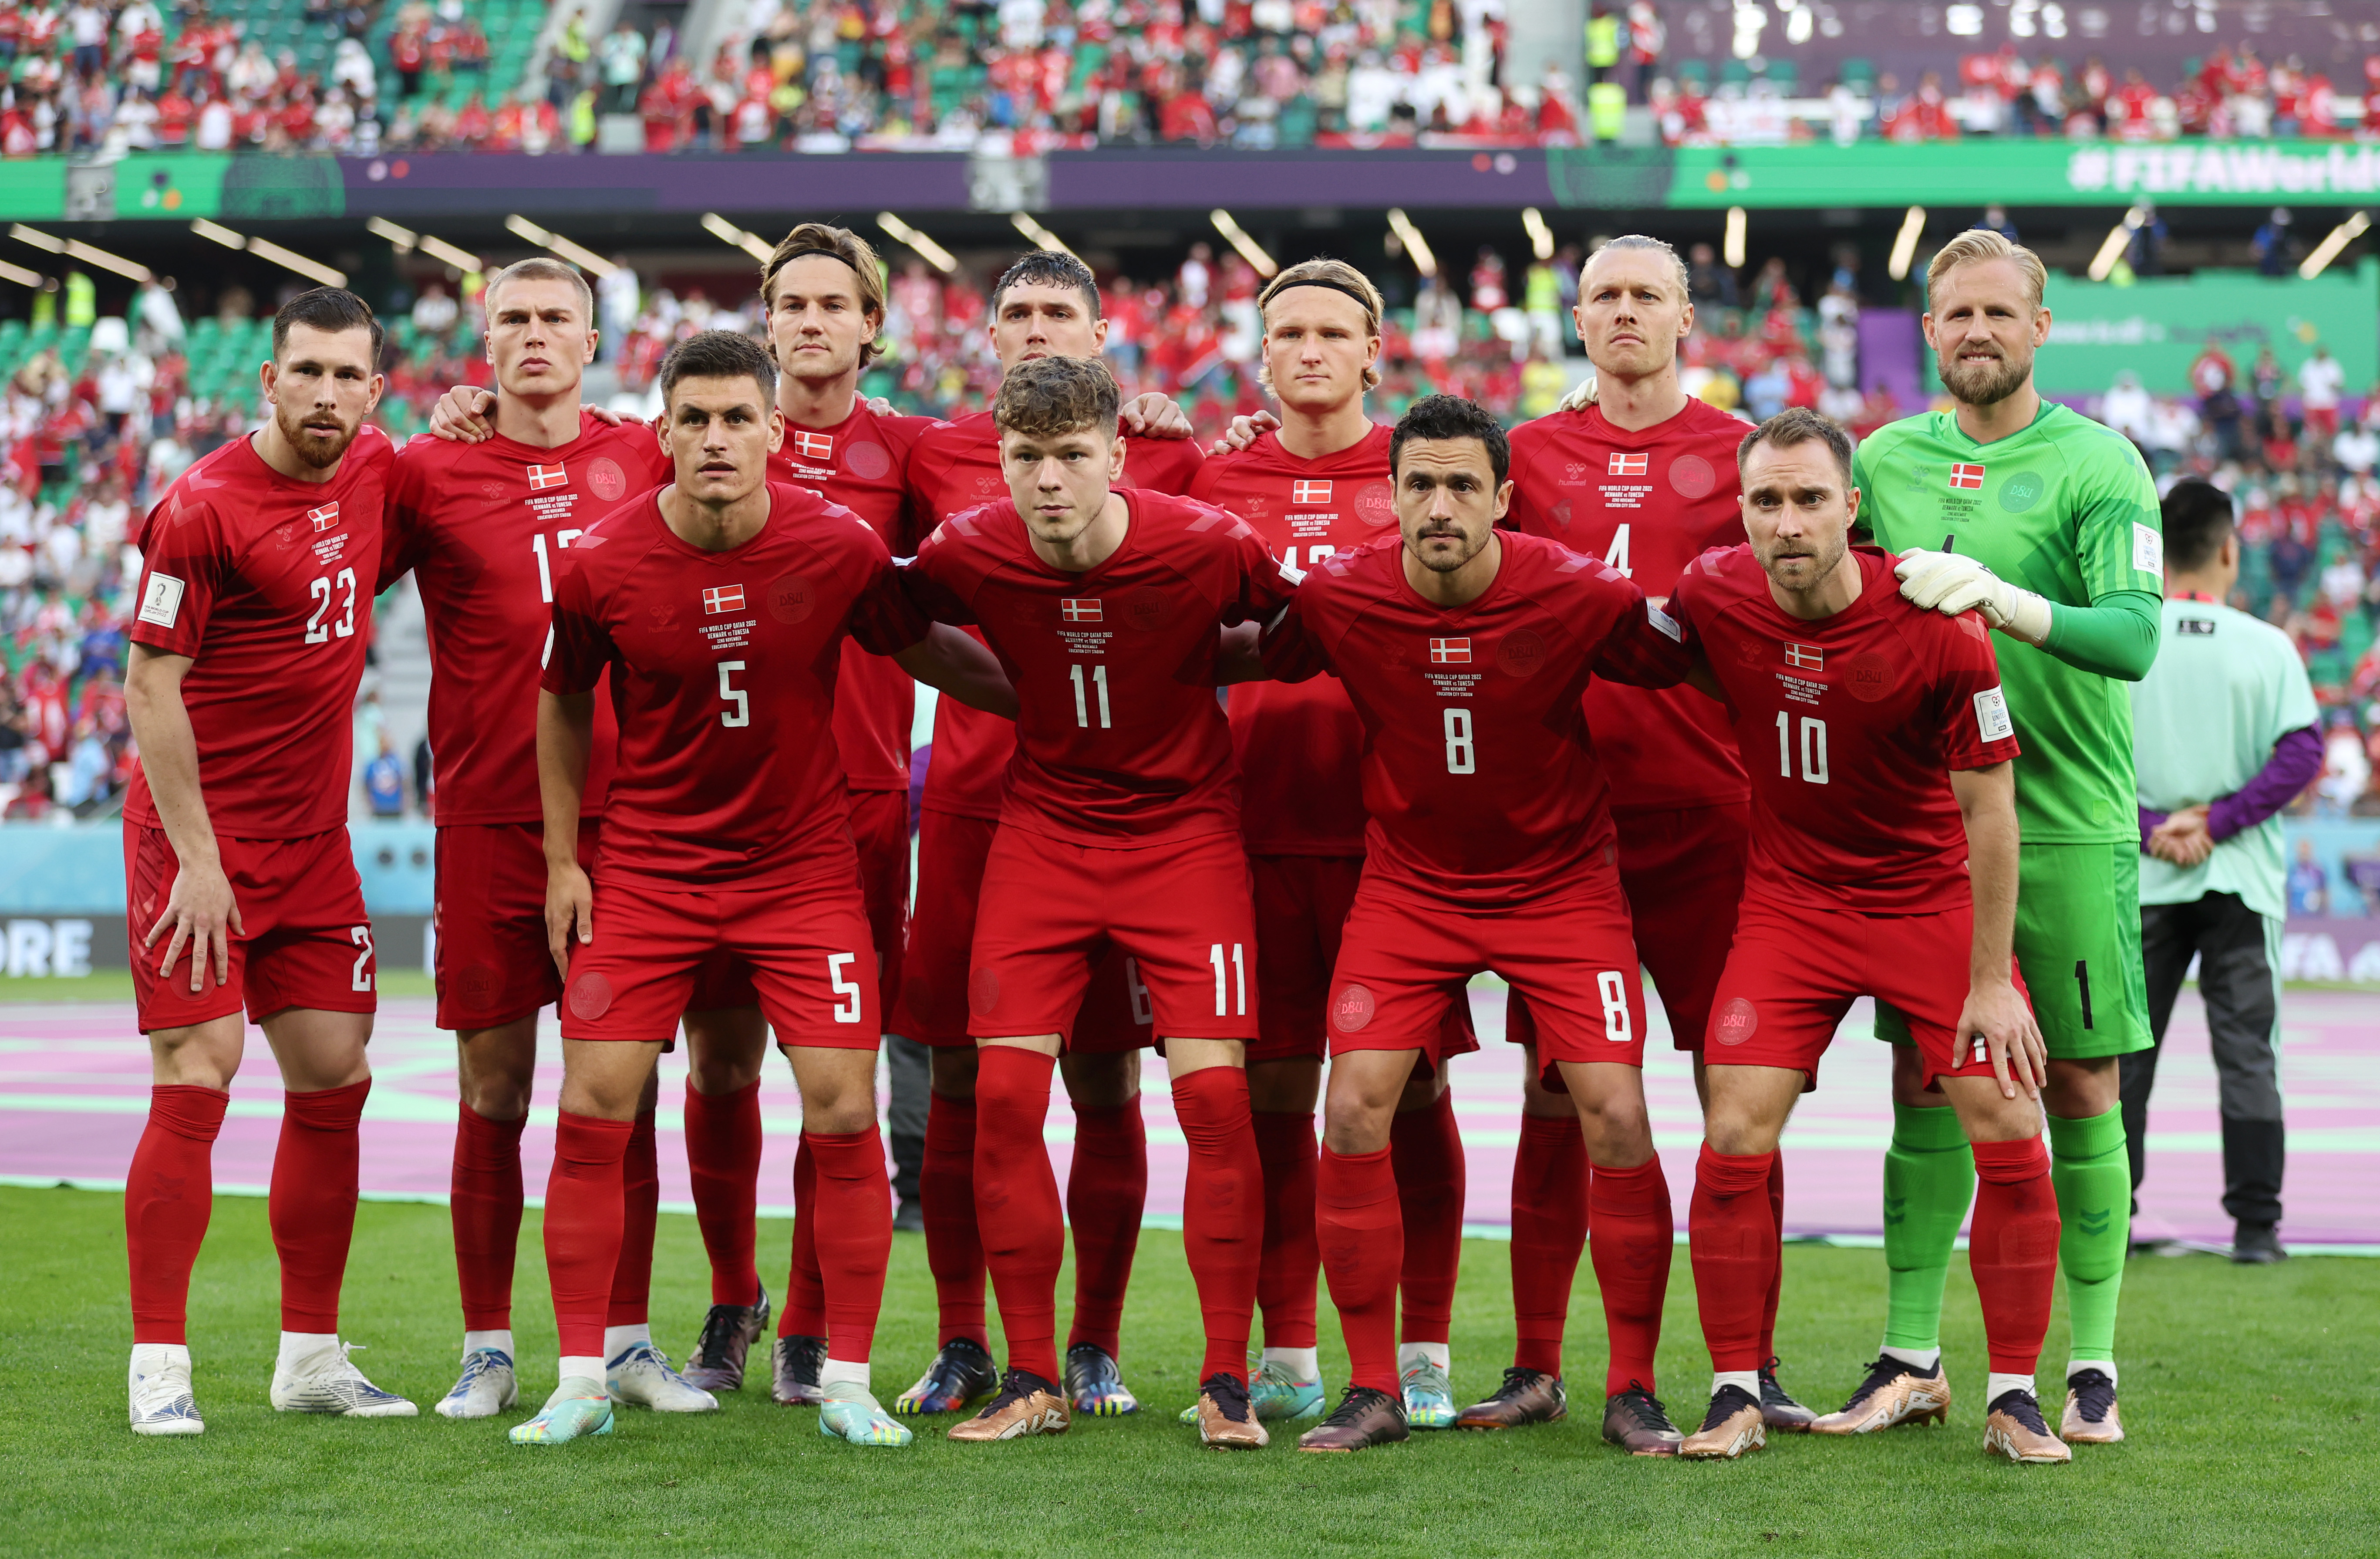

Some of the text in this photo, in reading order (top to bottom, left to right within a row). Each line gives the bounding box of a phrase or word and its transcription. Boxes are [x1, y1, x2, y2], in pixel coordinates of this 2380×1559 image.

[2067, 145, 2380, 193] #FIFAWorld
[595, 472, 617, 484] DBU
[2009, 485, 2034, 498] DBU
[481, 496, 511, 507] hummel
[1243, 510, 1268, 519] hummel
[1365, 497, 1391, 510] DBU
[532, 529, 583, 603] 1
[1604, 523, 1633, 579] 4
[305, 567, 357, 644] 23
[779, 591, 804, 607] DBU
[707, 631, 727, 639] DENMARK
[1738, 657, 1763, 672] hummel
[1785, 675, 1797, 684] WORLD
[1856, 670, 1882, 683] DBU
[718, 661, 749, 727] 5
[1069, 664, 1111, 728] 11
[1783, 682, 1800, 691] DENMARK
[1805, 687, 1821, 695] TUNESIA
[1992, 712, 2006, 721] UNITES
[1443, 708, 1475, 774] 8
[1776, 711, 1829, 784] 10
[0, 918, 92, 979] RE
[351, 925, 377, 992] 2
[827, 952, 861, 1023] 5
[1210, 943, 1246, 1016] 11
[2074, 960, 2093, 1030] 1
[1341, 1001, 1364, 1015] DBU
[1597, 971, 1632, 1042] 8
[1723, 1014, 1747, 1027] DBU
[994, 1408, 1068, 1441] AIR
[1849, 1390, 1943, 1435] AIR
[1727, 1422, 1766, 1456] AIR
[1984, 1424, 2021, 1461] AIR
